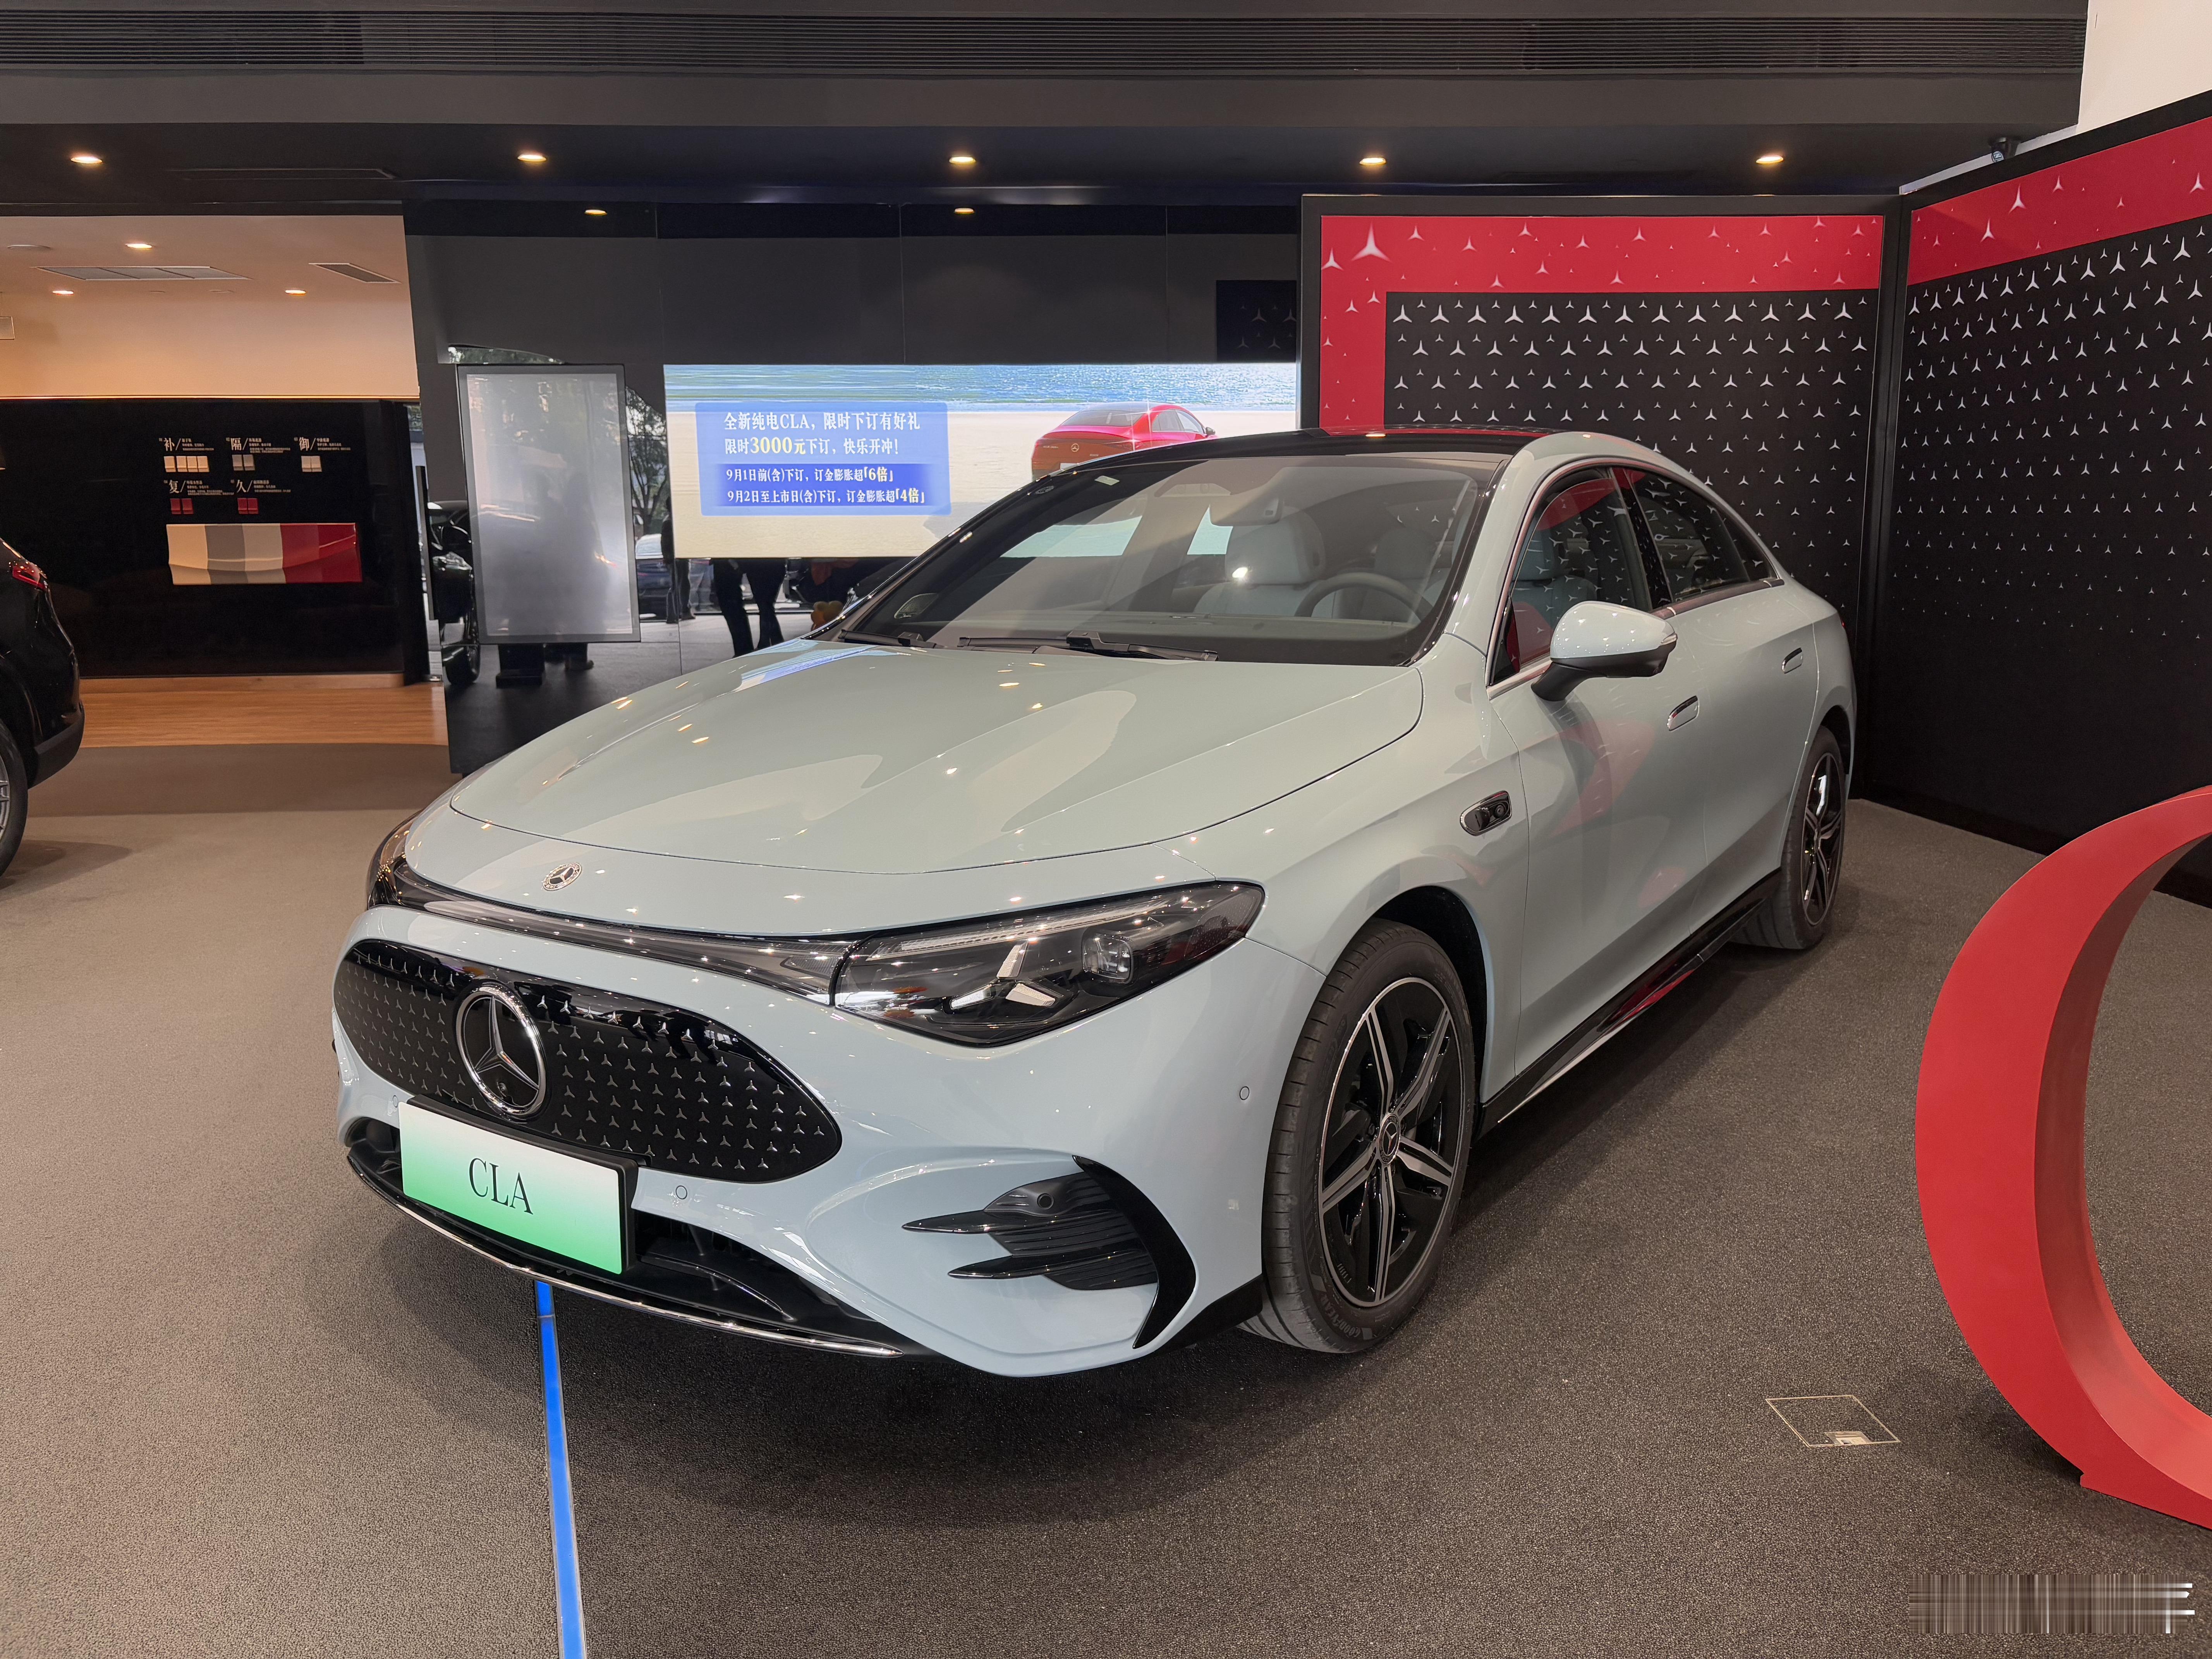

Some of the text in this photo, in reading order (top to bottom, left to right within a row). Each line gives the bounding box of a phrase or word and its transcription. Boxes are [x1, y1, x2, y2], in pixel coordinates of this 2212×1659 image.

[724, 412, 920, 430] 全新纯电CLA，限时下订有好礼
[163, 438, 175, 451] 补
[230, 438, 242, 451] 隔
[299, 437, 309, 451] 御
[236, 479, 247, 493] 久
[469, 1158, 534, 1215] CLA
